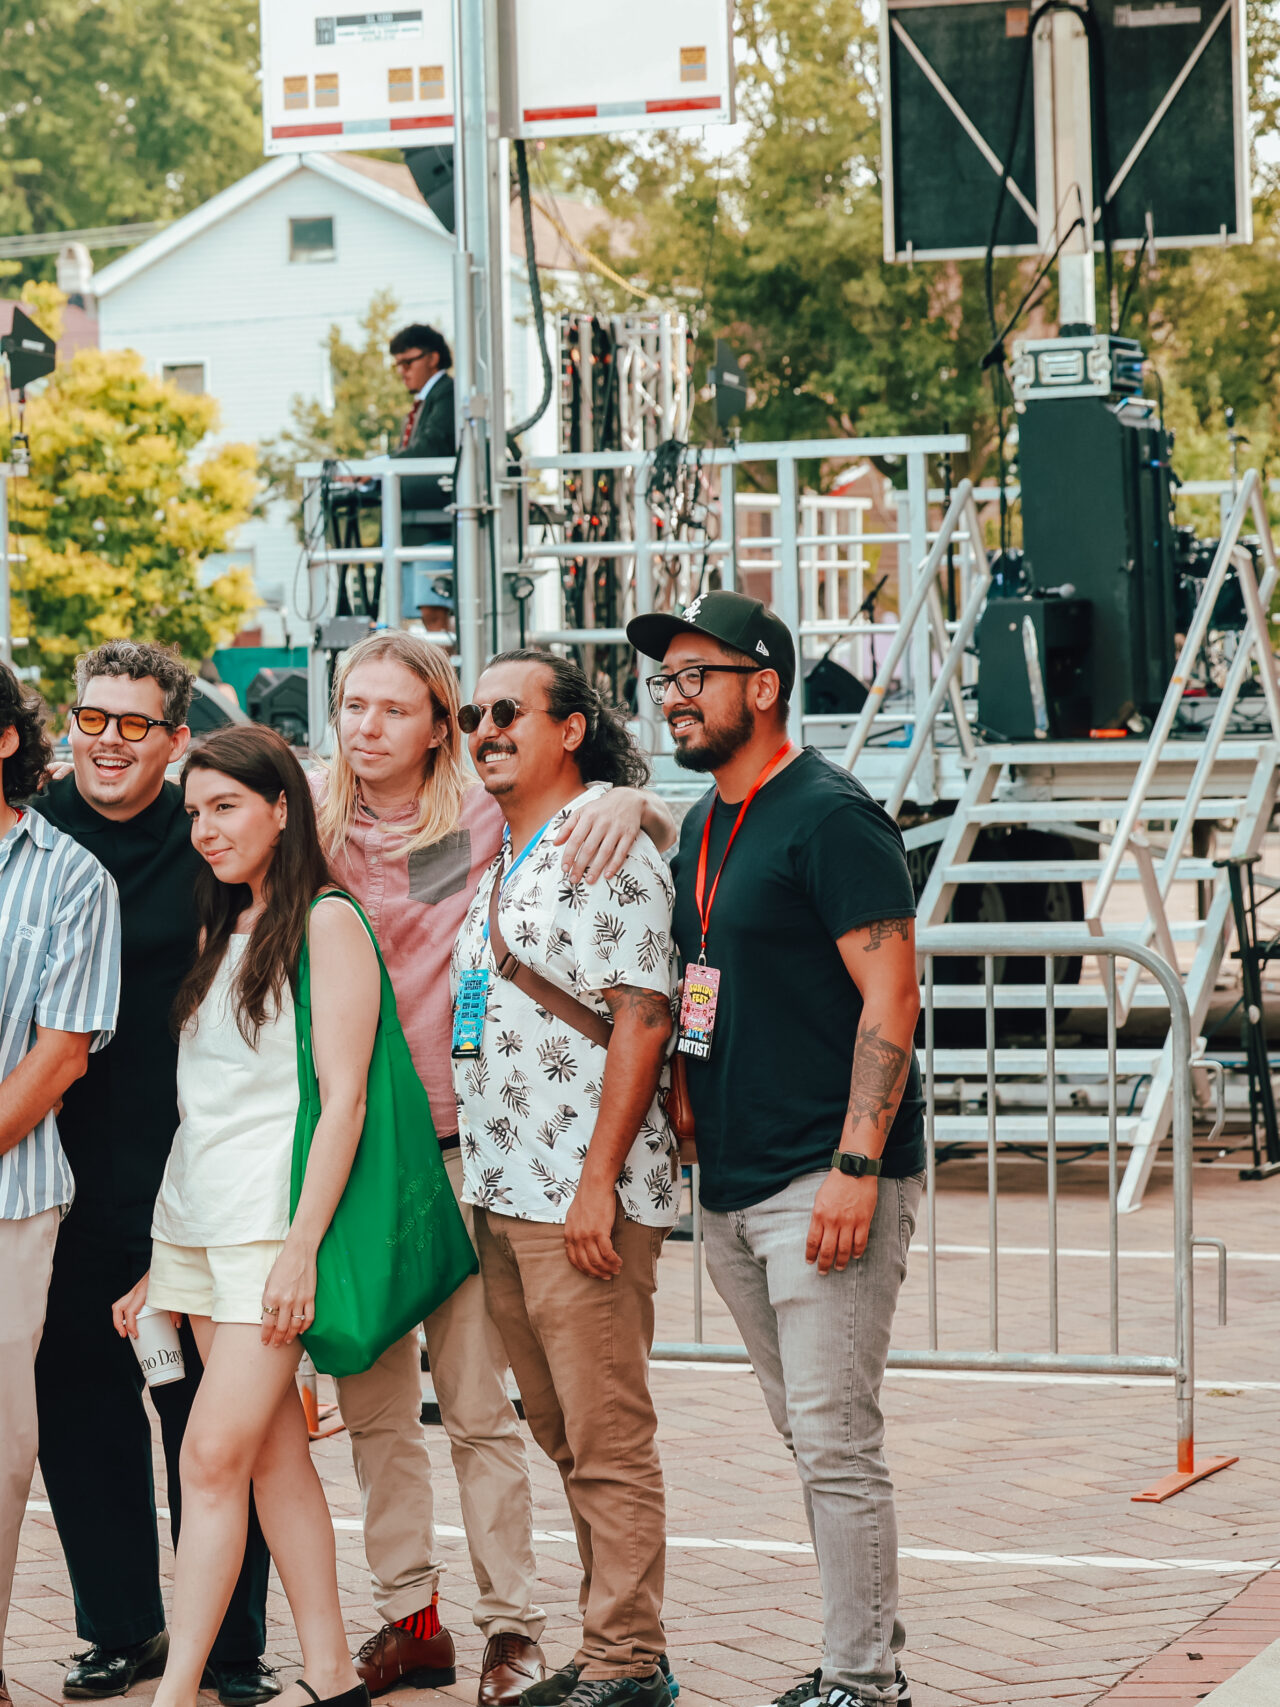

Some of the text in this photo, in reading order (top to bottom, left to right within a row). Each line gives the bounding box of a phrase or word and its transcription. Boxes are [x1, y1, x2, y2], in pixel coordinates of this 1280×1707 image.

[689, 983, 713, 996] SONIDO
[692, 993, 708, 1004] FEST
[677, 1038, 709, 1058] ARTIST
